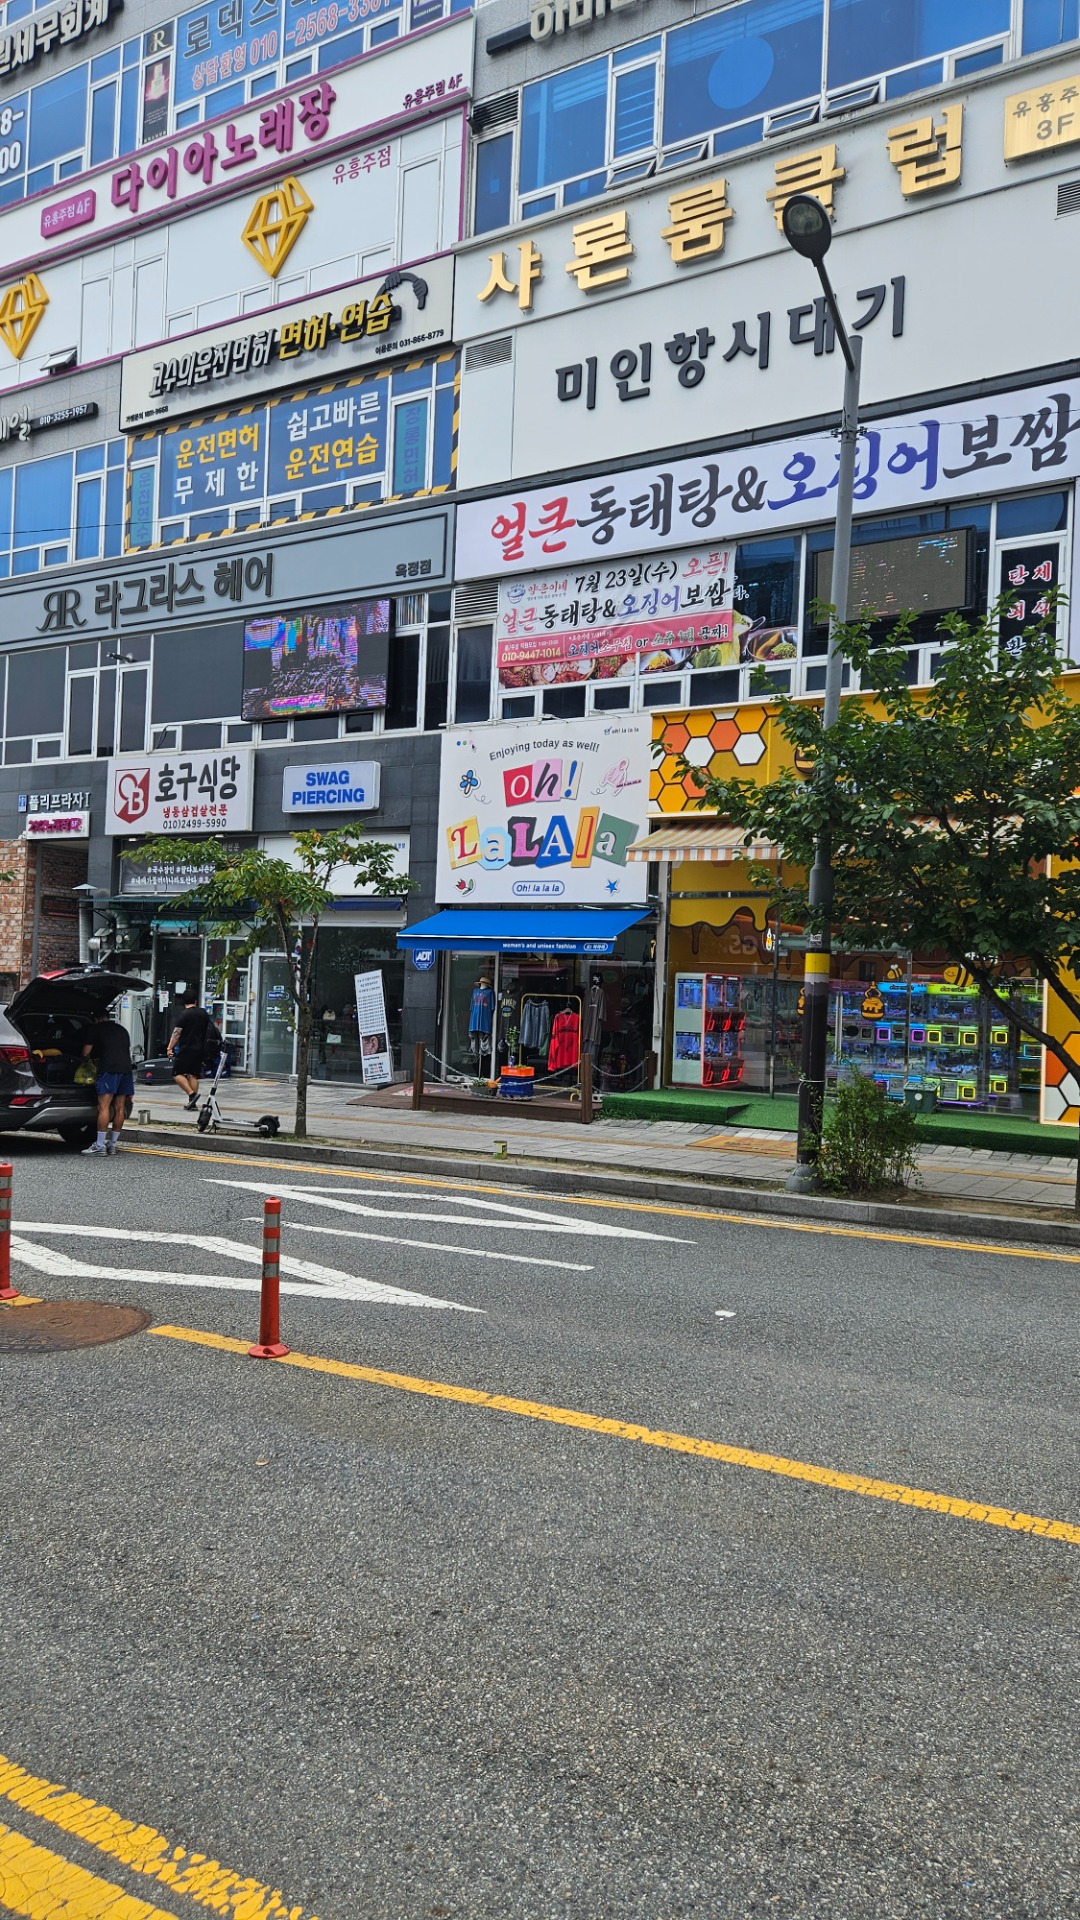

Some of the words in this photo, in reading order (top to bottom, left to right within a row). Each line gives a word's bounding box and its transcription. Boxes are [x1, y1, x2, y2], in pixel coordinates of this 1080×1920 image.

[151, 30, 169, 52] R
[192, 42, 246, 90] 상담환영
[250, 30, 277, 65] 010
[403, 80, 446, 109] 유흥주점
[448, 74, 463, 90] 4F
[1036, 111, 1075, 140] 3F
[110, 82, 337, 213] 다이아노래장
[332, 145, 391, 185] 유흥주점
[43, 203, 75, 229] 유흥주점
[77, 198, 91, 214] 4F
[149, 328, 277, 397] 고수의운전면허
[279, 292, 394, 361] 면허·연습
[555, 275, 906, 411] 미인항시대기
[40, 405, 88, 425] 010-3255-1957
[286, 391, 381, 443] 쉽고빠른
[175, 423, 260, 468] 운전면허
[285, 433, 379, 482] 운전연습
[491, 392, 1080, 562] 얼큰동태탕&오징어보쌈
[395, 560, 432, 578] 옥정점
[575, 571, 601, 594] 7월
[605, 561, 678, 590] 23일(수)
[682, 552, 730, 578] 오픈!
[1009, 562, 1052, 585] 단체
[95, 562, 205, 629] 라그라스
[214, 552, 274, 602] 헤어
[502, 577, 731, 634] 얼큰동태탕&오징어보쌈
[501, 647, 561, 663] 010-9447-1014
[636, 638, 649, 648] or
[489, 742, 530, 761] Enjoying
[533, 739, 560, 749] today
[562, 740, 574, 748] as
[576, 741, 600, 752] well!
[155, 755, 241, 803] 호구식당
[306, 770, 350, 786] SWAG
[163, 804, 228, 819] 냉동삼겹살전문
[292, 788, 365, 805] PIERCING
[163, 819, 227, 829] 010)2499-5990
[516, 884, 530, 892] Oh!
[533, 884, 540, 892] la
[542, 884, 549, 892] la
[552, 884, 559, 892] la
[415, 951, 432, 962] ADT
